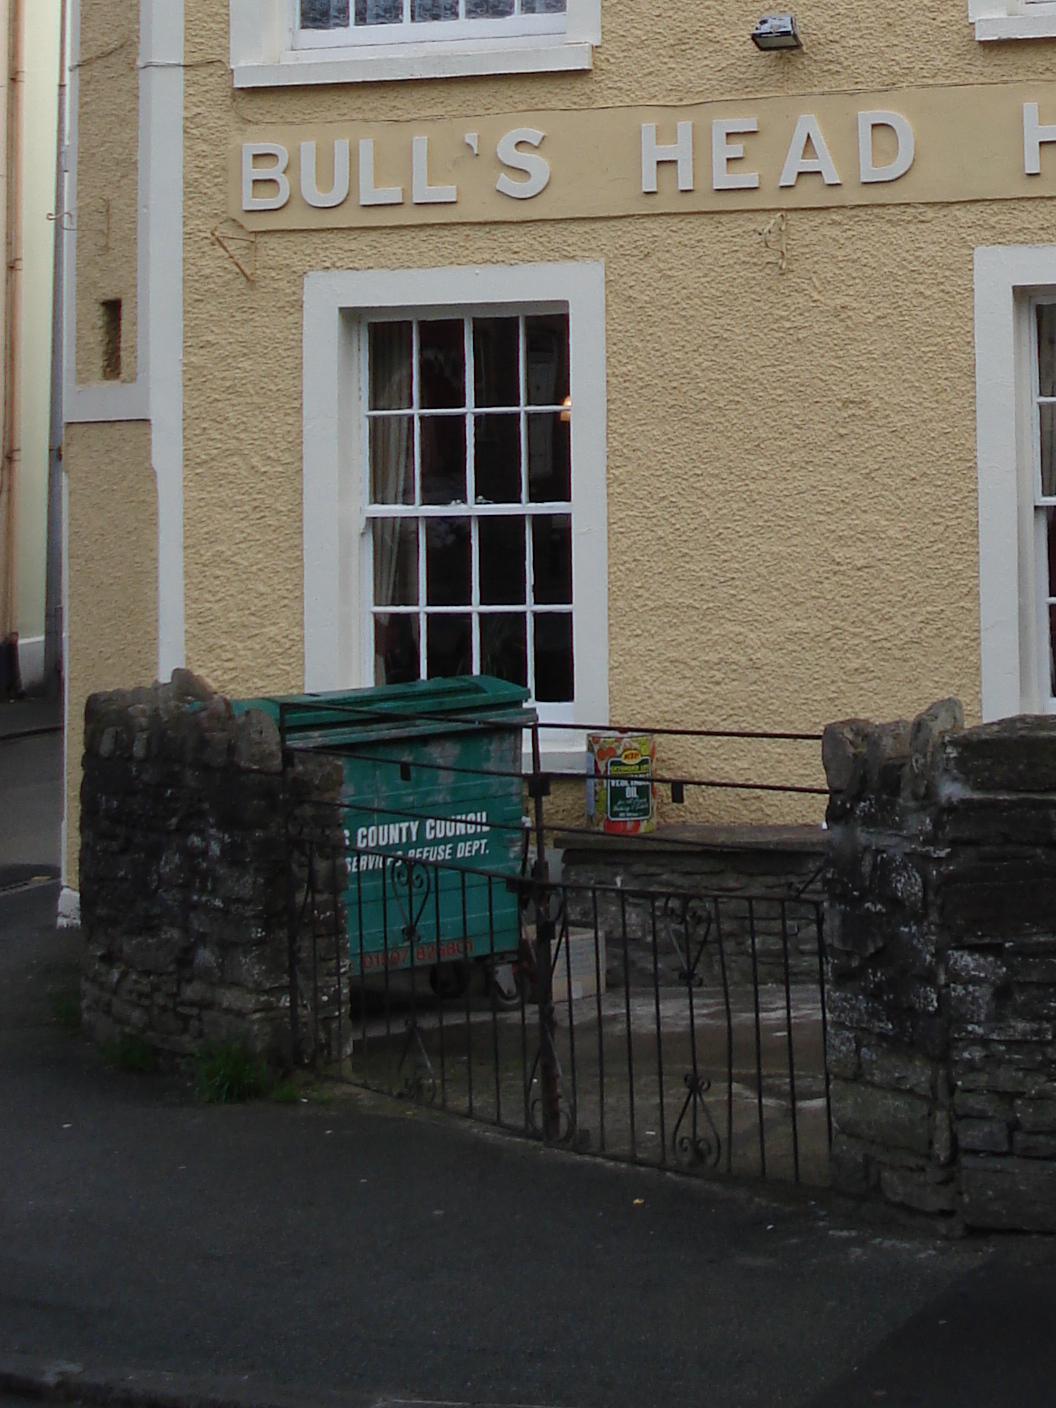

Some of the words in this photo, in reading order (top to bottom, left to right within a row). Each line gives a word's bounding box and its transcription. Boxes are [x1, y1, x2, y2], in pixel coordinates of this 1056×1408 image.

[242, 126, 550, 212] BULL'S
[641, 109, 917, 194] HEAD
[625, 787, 638, 798] OIL
[357, 820, 420, 849] COUNTY
[456, 838, 490, 859] DEPT.
